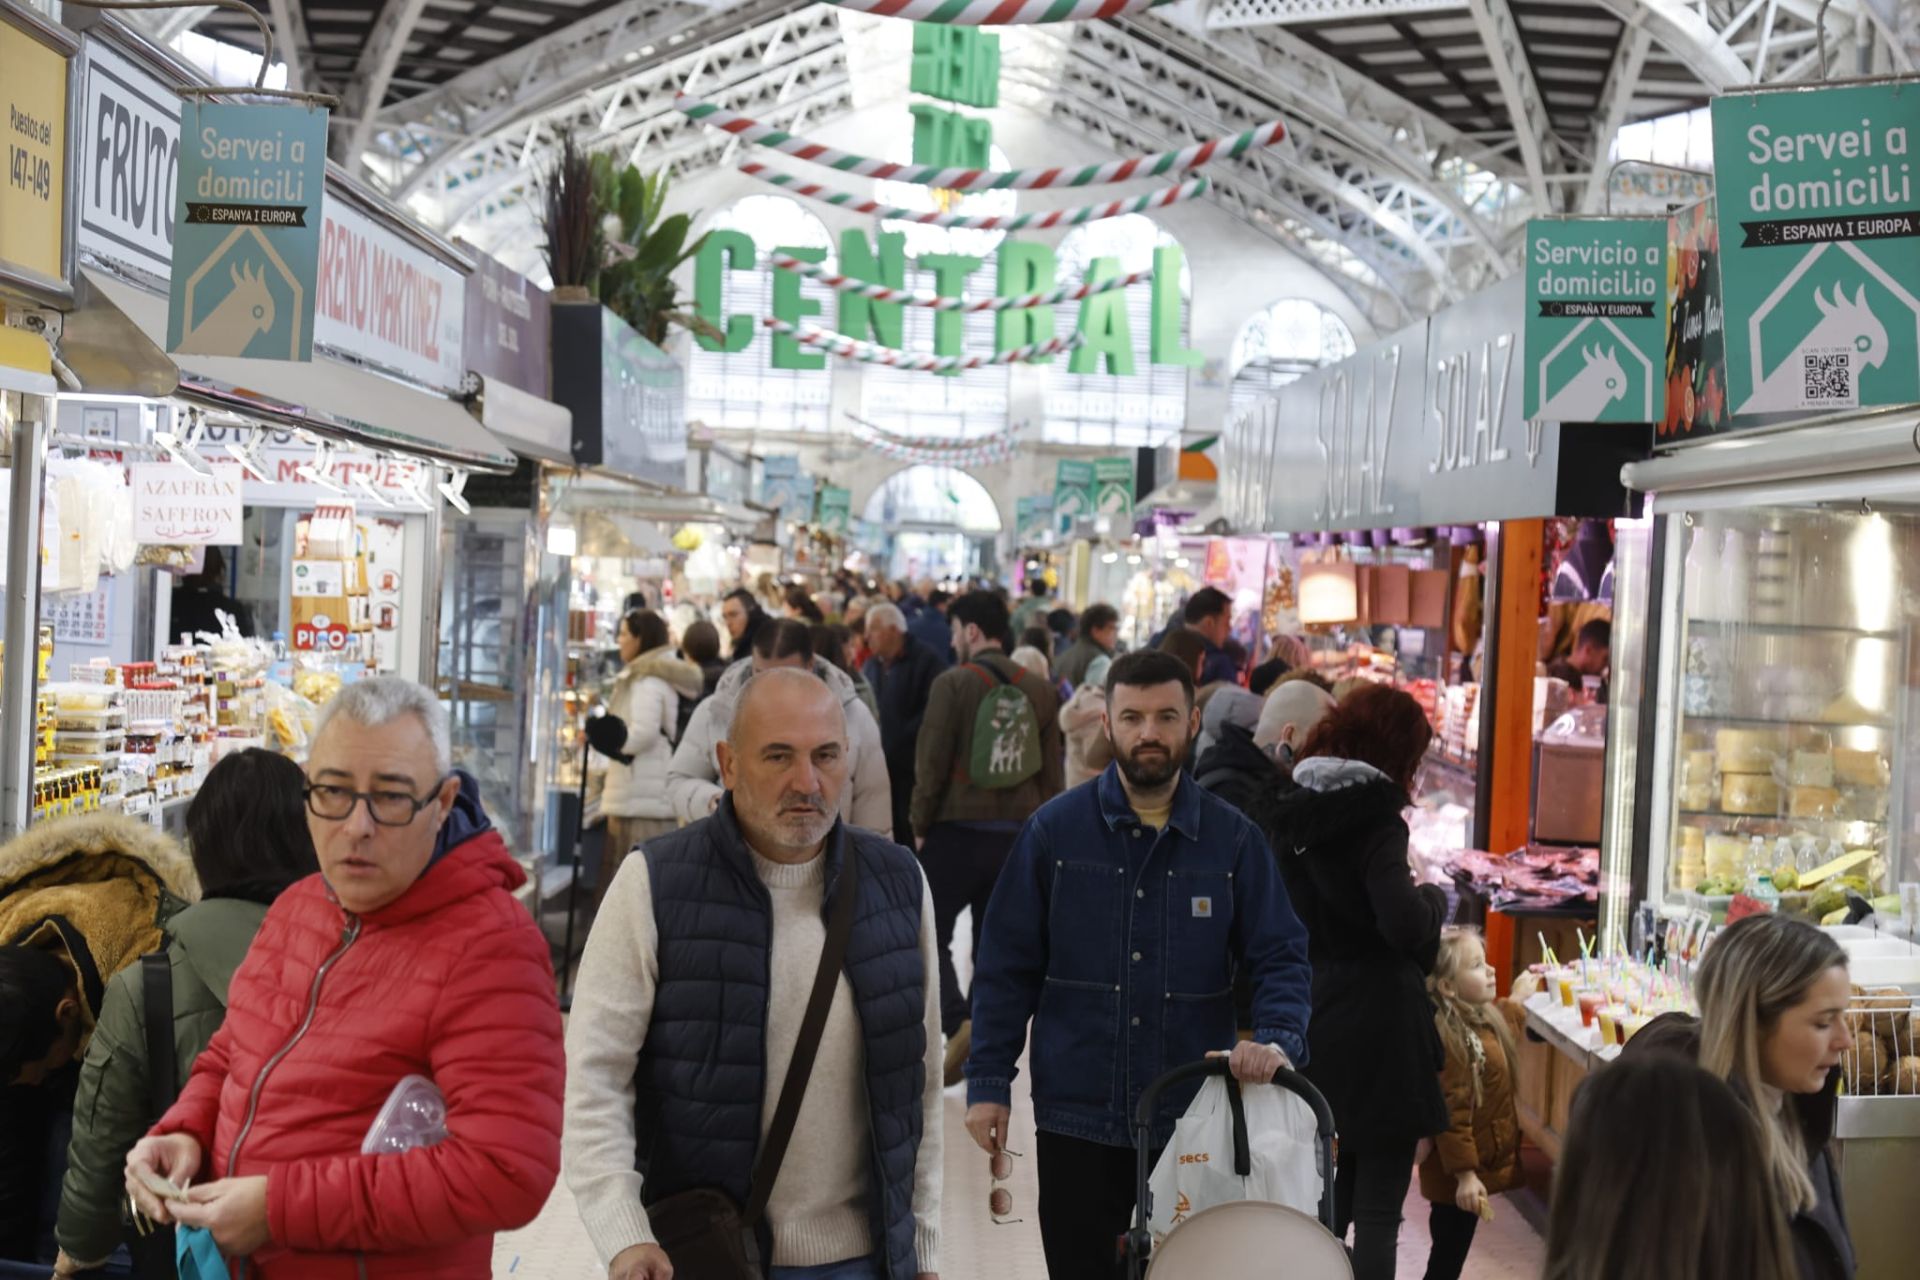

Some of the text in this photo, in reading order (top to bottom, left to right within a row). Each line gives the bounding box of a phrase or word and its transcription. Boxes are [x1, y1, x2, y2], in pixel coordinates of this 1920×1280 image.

[11, 103, 52, 146] Puestos del
[201, 127, 305, 163] Servei a
[1747, 118, 1907, 165] Servei a
[10, 144, 50, 201] 147-149
[198, 165, 304, 202] domicili
[1750, 163, 1910, 212] domicili
[212, 208, 297, 223] ESPANYA I EUROPA
[1783, 218, 1912, 240] ESPANYA I EUROPA
[1535, 237, 1659, 265] Servicio a
[1538, 269, 1657, 296] domicilio
[370, 243, 443, 364] MARTINEZ
[693, 228, 1205, 376] CENTRAL
[1565, 302, 1643, 315] ESPAÑA Y EUROPA
[1430, 332, 1515, 474] SOLAZ
[143, 478, 236, 496] AZAFRÁN
[141, 507, 233, 522] SAFFRON
[296, 630, 345, 647] PIO
[1178, 1153, 1209, 1164] secs
